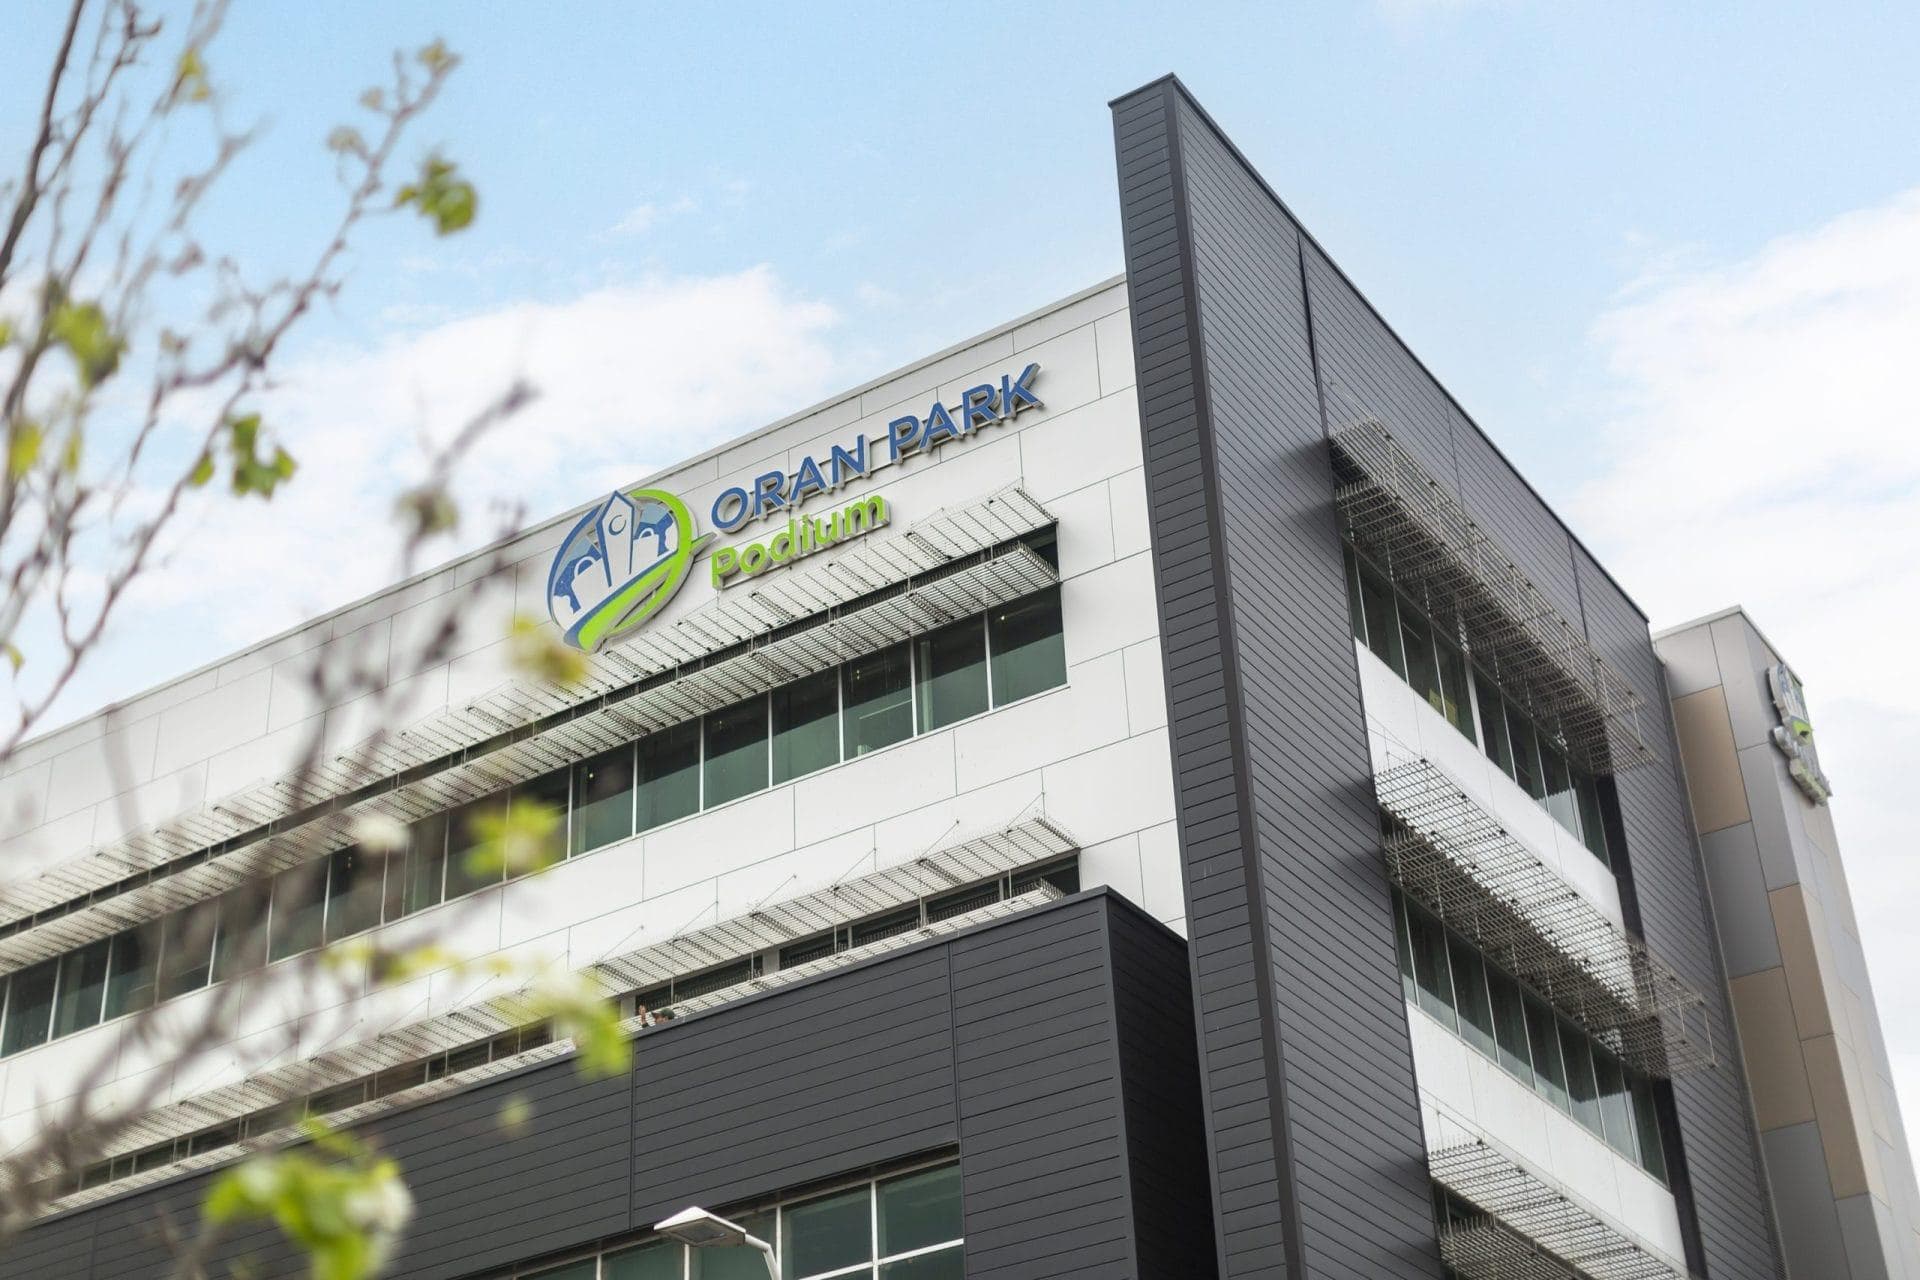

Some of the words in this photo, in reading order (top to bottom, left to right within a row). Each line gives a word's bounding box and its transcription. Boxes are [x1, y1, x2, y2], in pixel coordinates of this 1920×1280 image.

[711, 433, 867, 533] ORAN
[889, 363, 1043, 464] PARK
[711, 494, 889, 588] Podium
